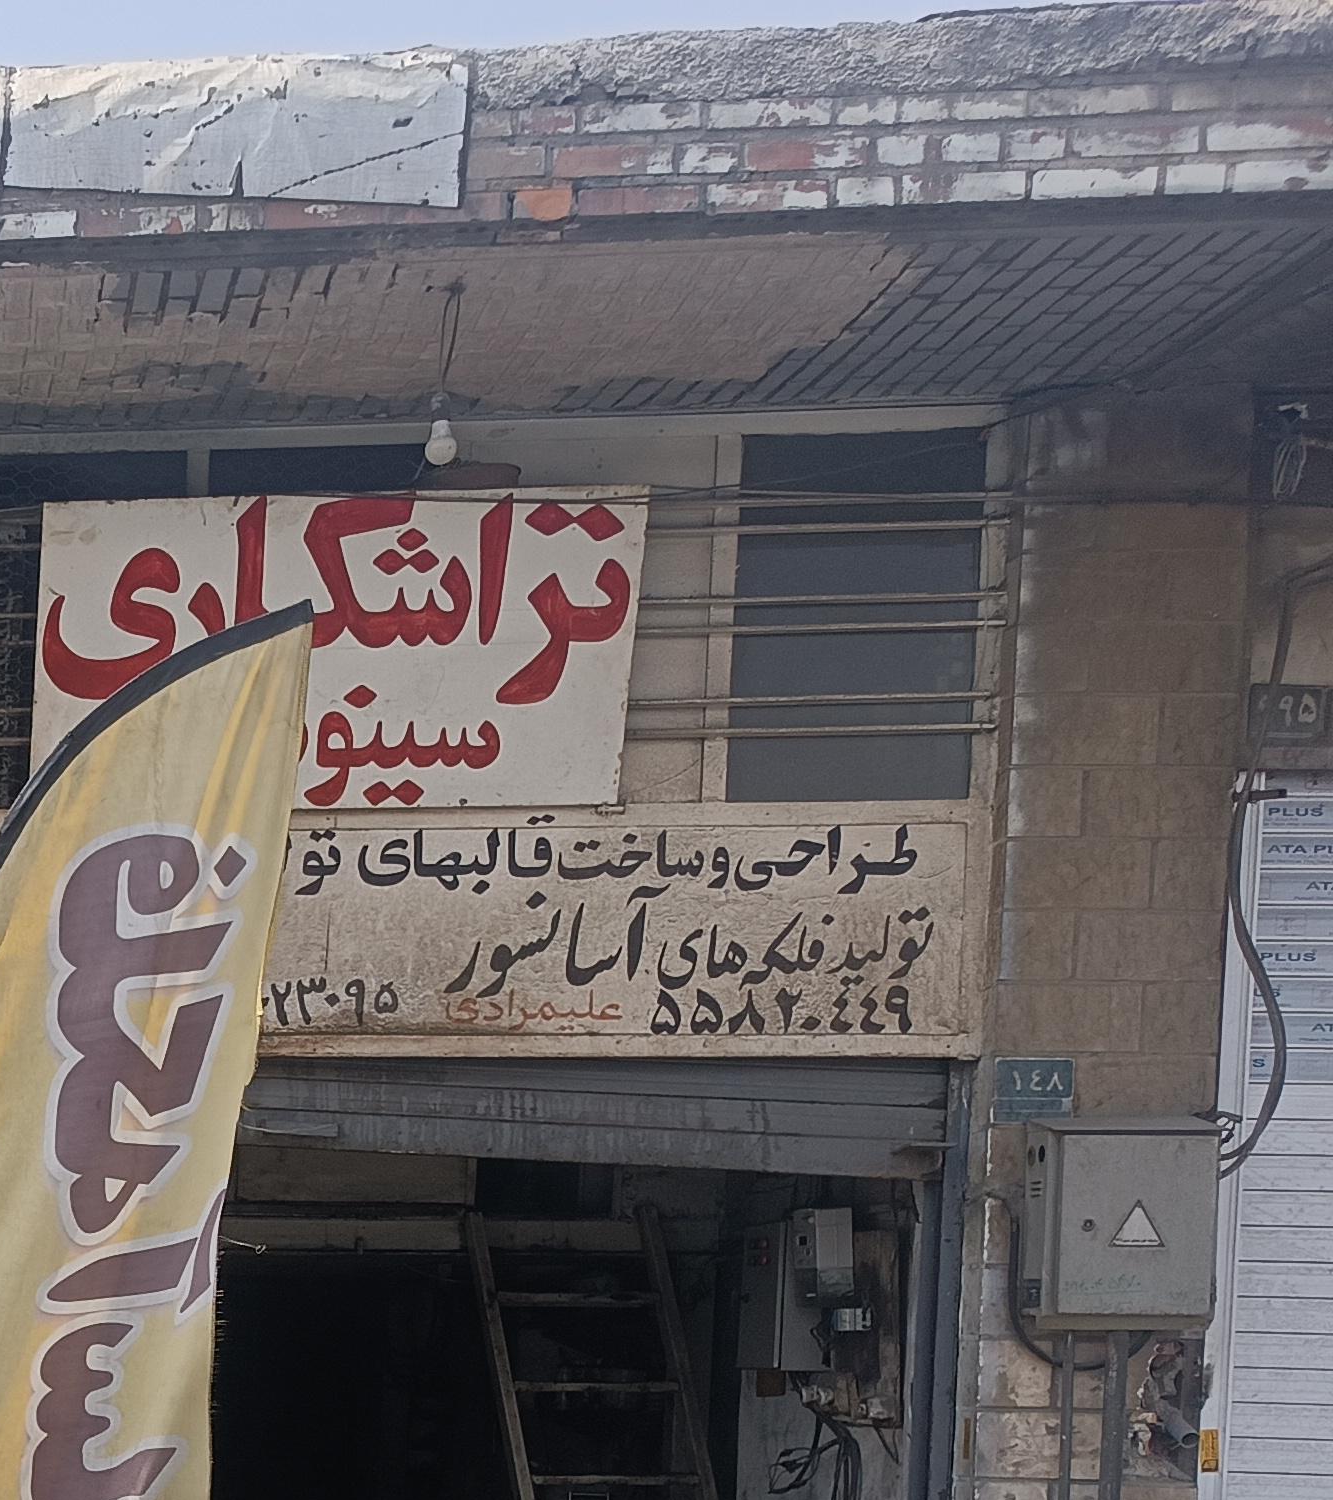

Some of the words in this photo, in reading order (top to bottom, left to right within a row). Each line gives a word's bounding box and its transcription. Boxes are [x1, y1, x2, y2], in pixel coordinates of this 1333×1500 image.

[42, 493, 631, 704] تراشکاری
[300, 684, 501, 807] سینو
[357, 814, 556, 892] قالبهای
[734, 824, 918, 894] طراحی
[1267, 845, 1307, 854] ATA
[1314, 845, 1333, 854] PL
[1306, 881, 1333, 891] AT
[442, 883, 671, 998] آسانسور
[826, 905, 934, 989] تولید
[444, 988, 624, 1032] علیمرادی
